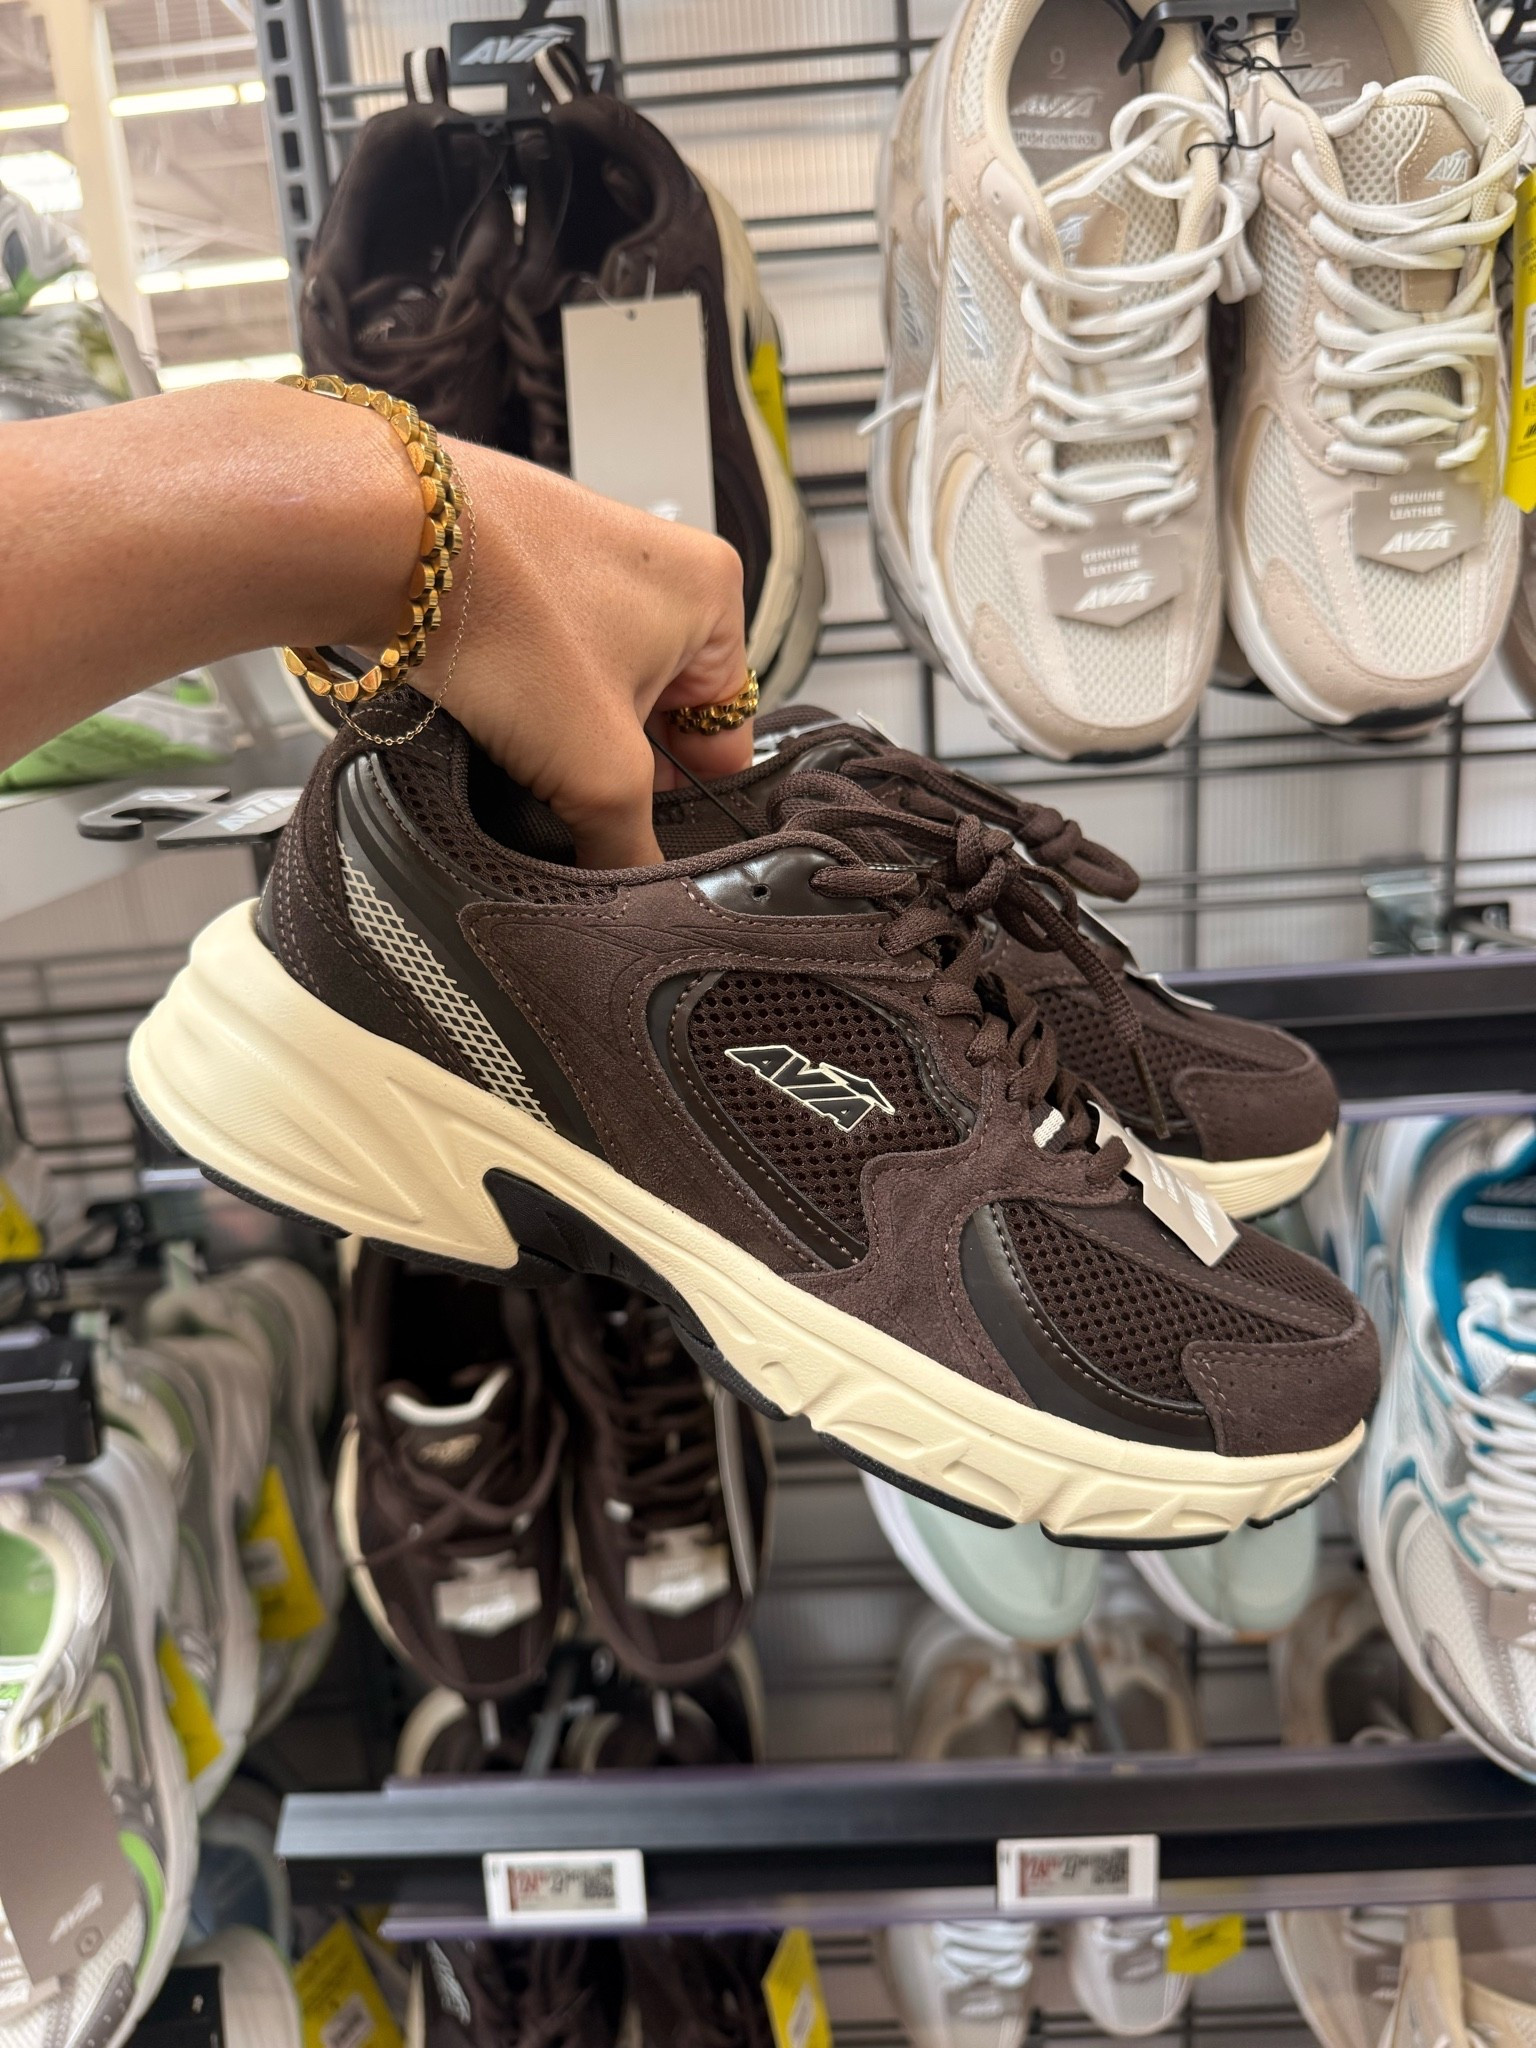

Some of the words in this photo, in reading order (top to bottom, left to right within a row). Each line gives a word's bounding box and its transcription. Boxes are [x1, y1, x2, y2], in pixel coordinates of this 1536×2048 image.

[1379, 522, 1459, 555] AVIA
[1073, 572, 1155, 613] AVIA
[724, 1044, 896, 1133] AVIA
